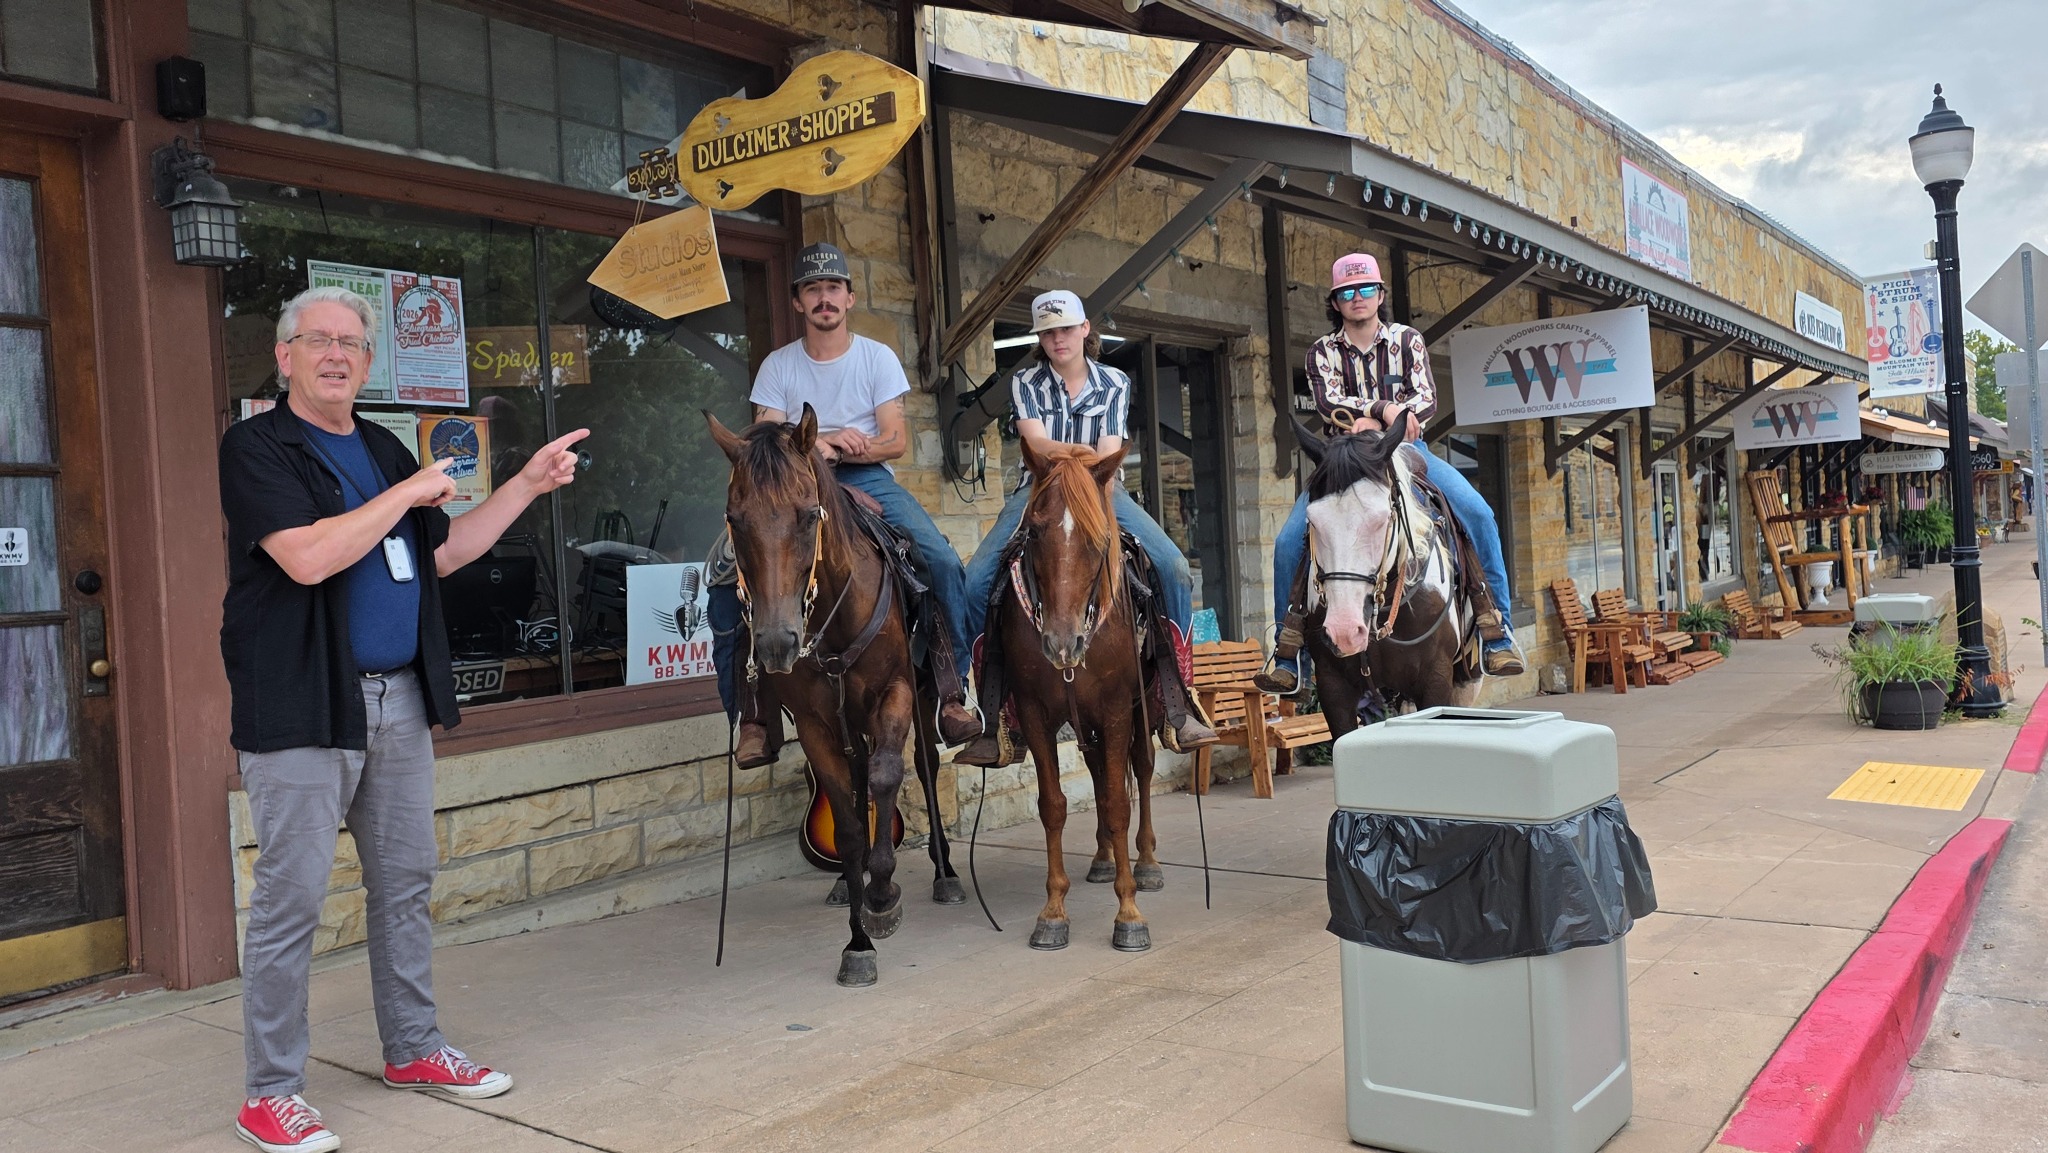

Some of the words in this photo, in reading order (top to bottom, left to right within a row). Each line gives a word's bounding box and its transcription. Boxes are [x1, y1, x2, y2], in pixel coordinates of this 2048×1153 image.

[697, 121, 791, 170] DULCIMER
[799, 97, 876, 143] SHOPPE
[618, 229, 712, 279] Studios
[392, 275, 405, 284] AUG.
[437, 281, 450, 290] AUG.
[315, 277, 344, 288] PINE
[349, 281, 382, 296] LEAF
[1878, 286, 1920, 298] STRUM
[1892, 294, 1923, 304] SHOP
[402, 309, 418, 319] 2026
[400, 322, 442, 336] Bluegrass
[397, 333, 421, 348] Fried
[423, 331, 458, 344] Chicken
[1483, 343, 1505, 373] WALLACE
[1504, 323, 1554, 346] WOODWORKS
[1556, 323, 1583, 332] CRAFTS
[1584, 328, 1590, 336] &
[1591, 332, 1617, 358] APPAREL
[1876, 363, 1915, 371] MOUNTAIN
[1492, 375, 1508, 383] EST.
[1492, 405, 1526, 416] CLOTHING
[1527, 402, 1562, 412] BOUTIQUE
[1568, 397, 1617, 408] ACCESSORIES
[1892, 452, 1932, 462] PEABODY
[1972, 453, 1992, 464] 2560
[648, 641, 714, 666] KWM
[654, 664, 690, 679] 88.5
[696, 661, 717, 674] FM
